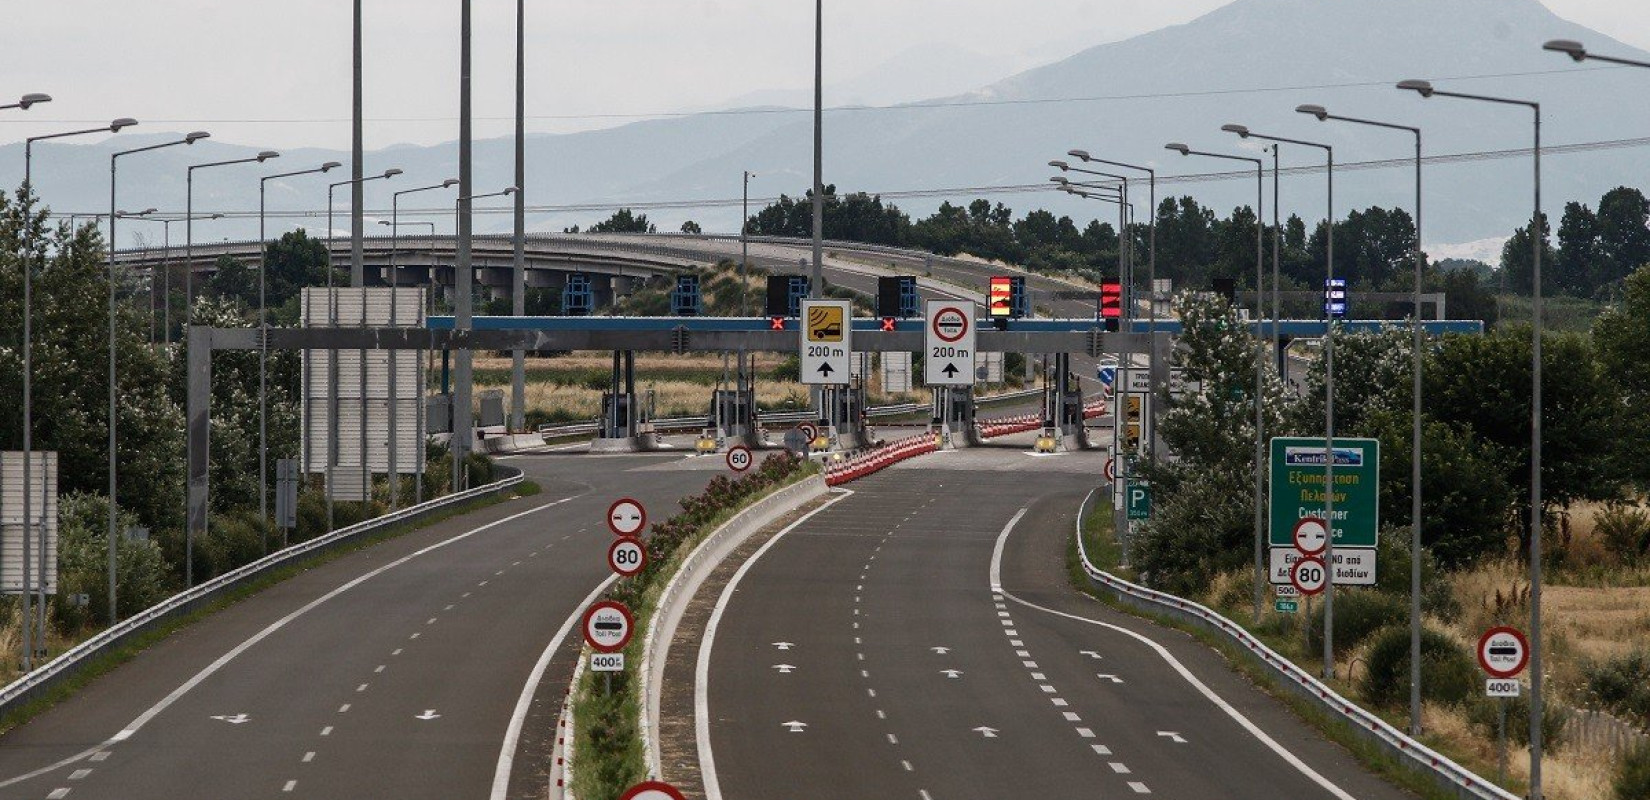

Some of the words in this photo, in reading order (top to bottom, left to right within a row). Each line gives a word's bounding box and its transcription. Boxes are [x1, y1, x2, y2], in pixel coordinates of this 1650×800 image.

[808, 346, 829, 357] 200
[832, 349, 843, 357] m
[933, 347, 954, 358] 200
[957, 350, 968, 358] m
[732, 453, 747, 464] 60
[1132, 489, 1145, 507] P
[617, 550, 638, 564] 80
[1299, 568, 1321, 582] 80
[593, 657, 615, 667] 400
[1489, 682, 1511, 692] 400
